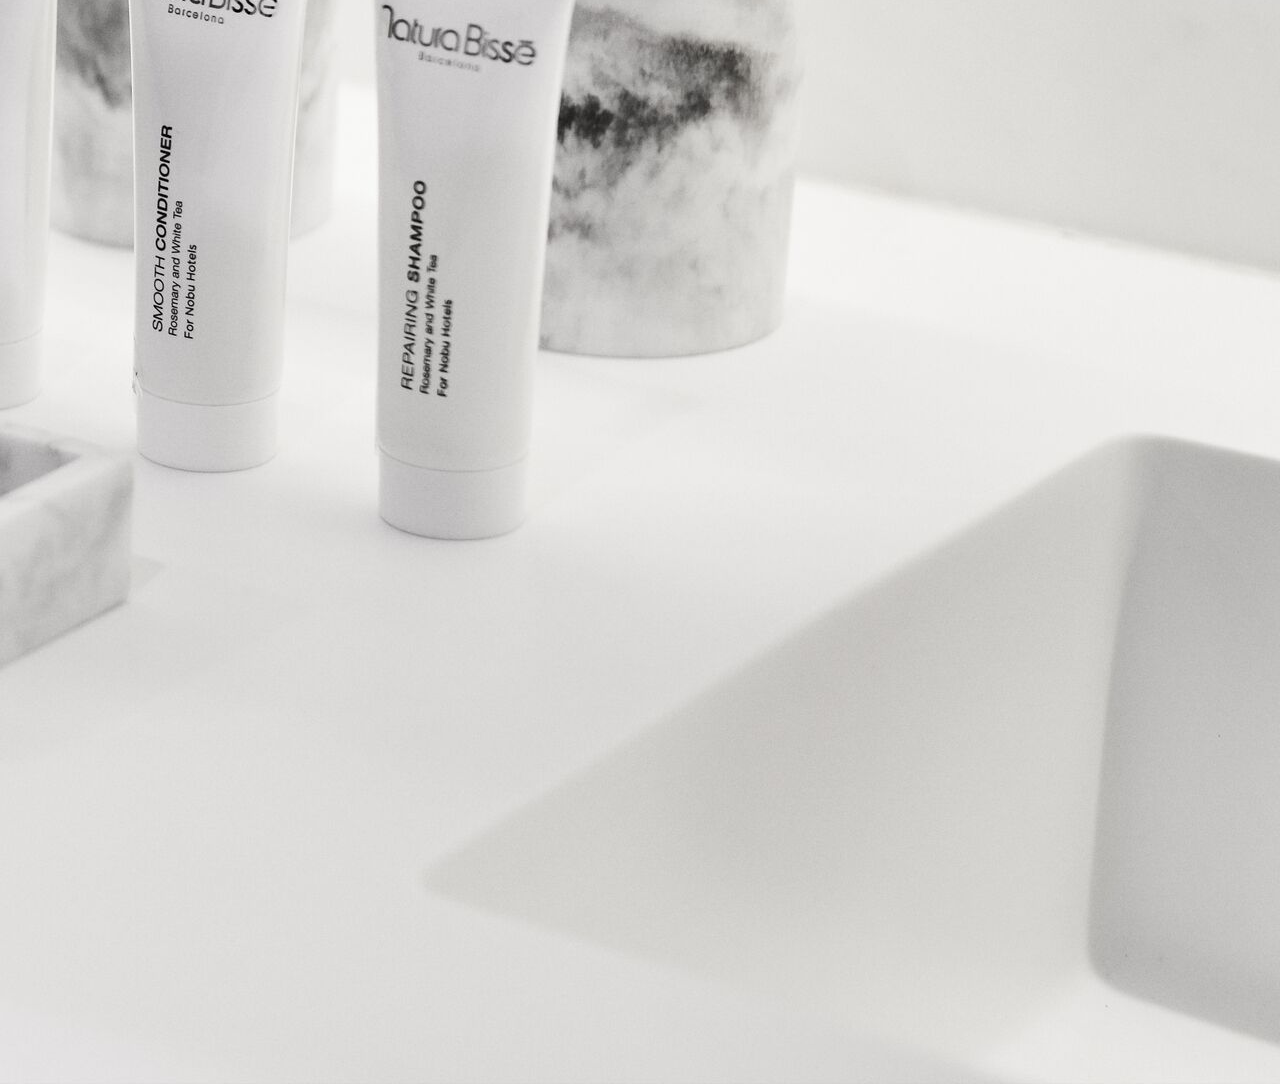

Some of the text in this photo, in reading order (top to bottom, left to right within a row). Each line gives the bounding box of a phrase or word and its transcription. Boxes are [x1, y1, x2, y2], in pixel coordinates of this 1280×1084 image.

[167, 3, 225, 24] Barcelona
[152, 125, 172, 332] SMOOTH CONDITIONER
[168, 200, 183, 336] Rosemary and White Tea
[184, 244, 197, 339] For Nobu Hotels
[400, 180, 426, 391] REPAIRING SHAMPOO
[419, 254, 438, 394] Rosemary and White Tea
[437, 299, 452, 397] For Nobu Hotels
